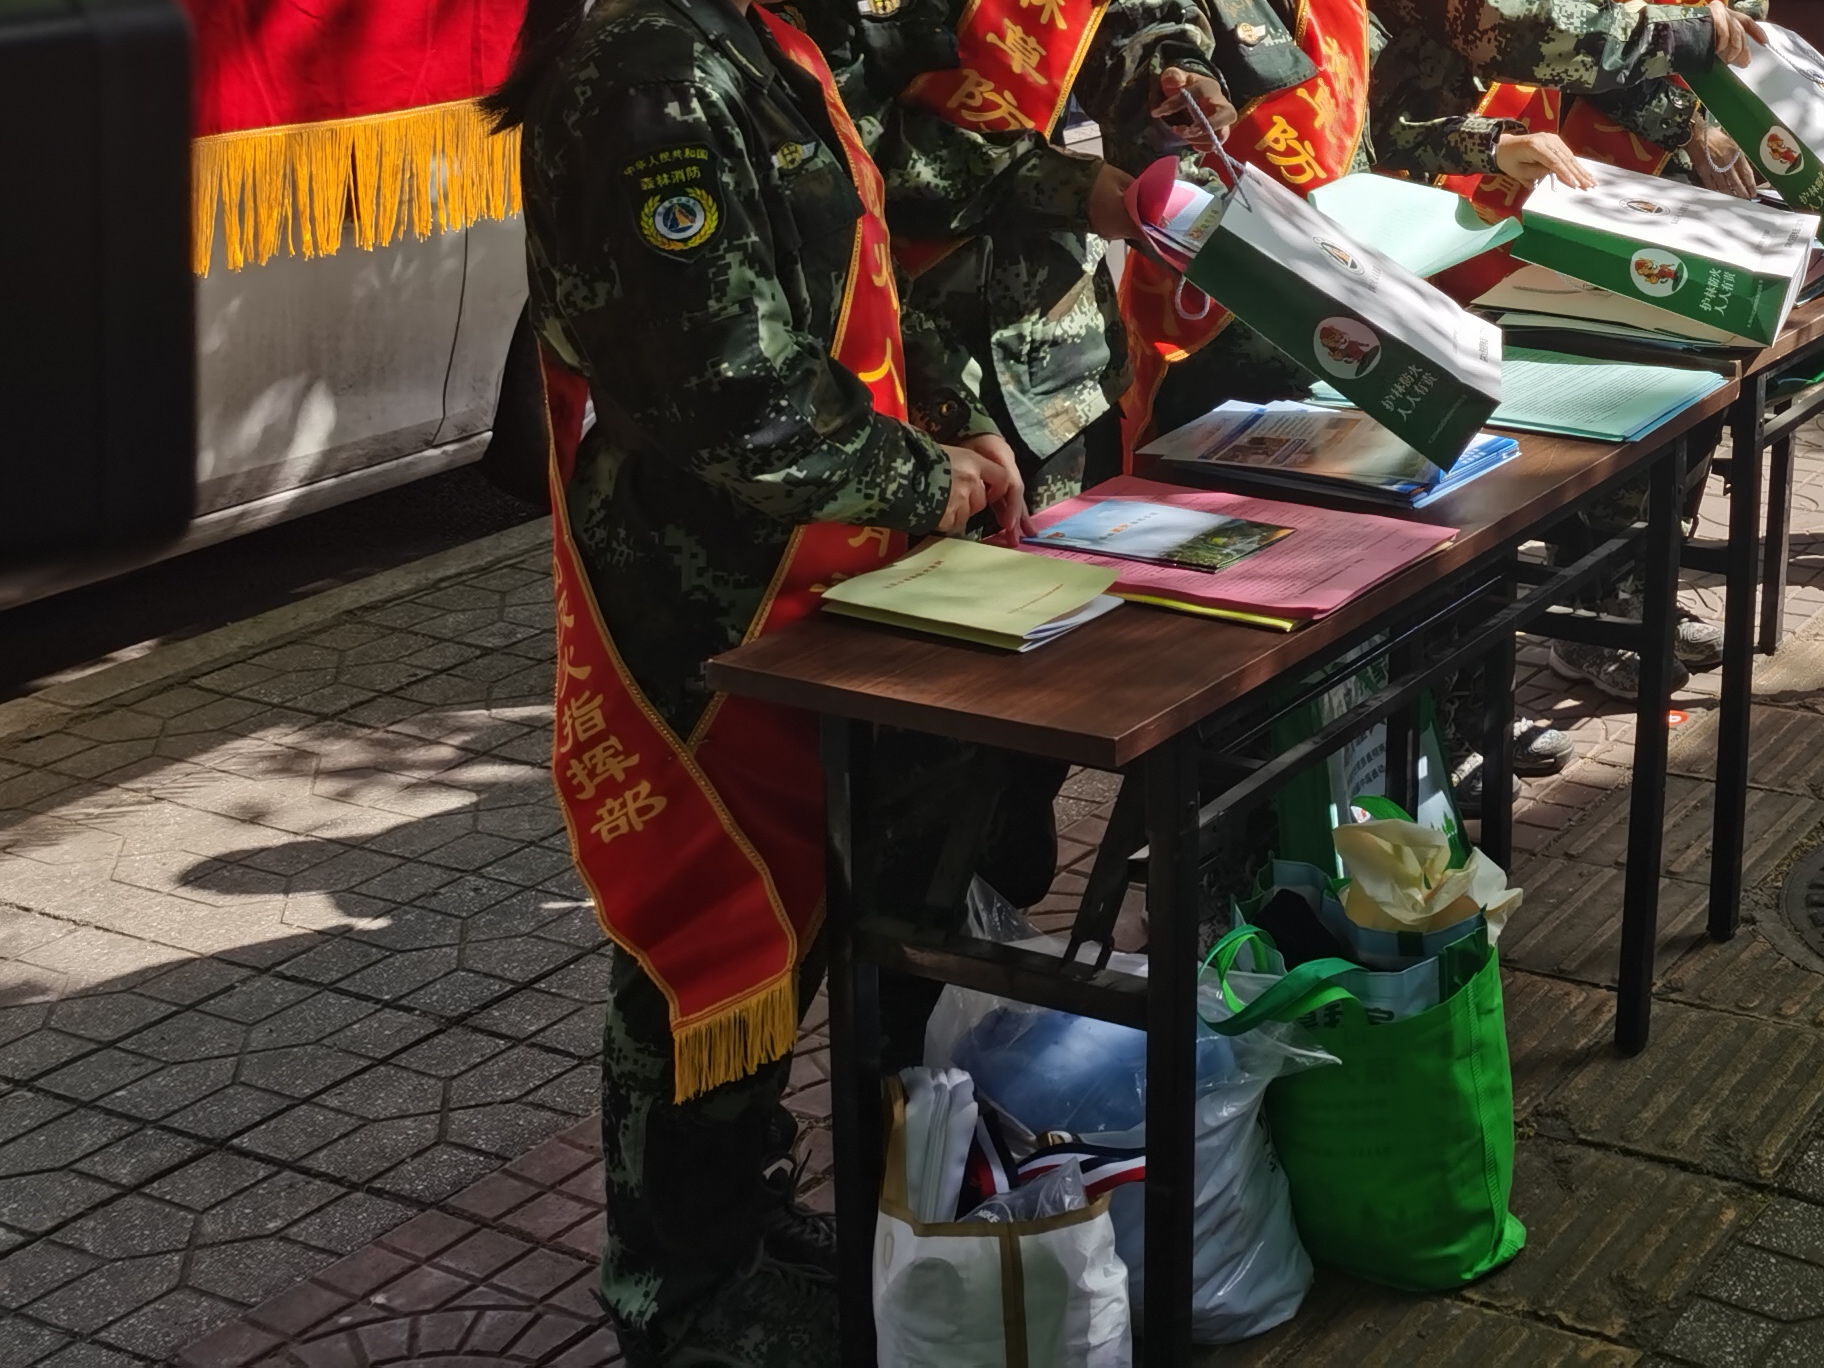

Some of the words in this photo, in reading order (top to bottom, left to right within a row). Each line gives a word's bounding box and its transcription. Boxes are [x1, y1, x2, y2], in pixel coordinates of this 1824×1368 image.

[624, 147, 709, 177] 中华人民共和国
[640, 165, 701, 191] 森林消防
[1698, 267, 1722, 312] 护林防火
[1714, 270, 1737, 318] 人人有责
[1380, 363, 1424, 413] 护林防火
[1396, 372, 1439, 423] 人人有责
